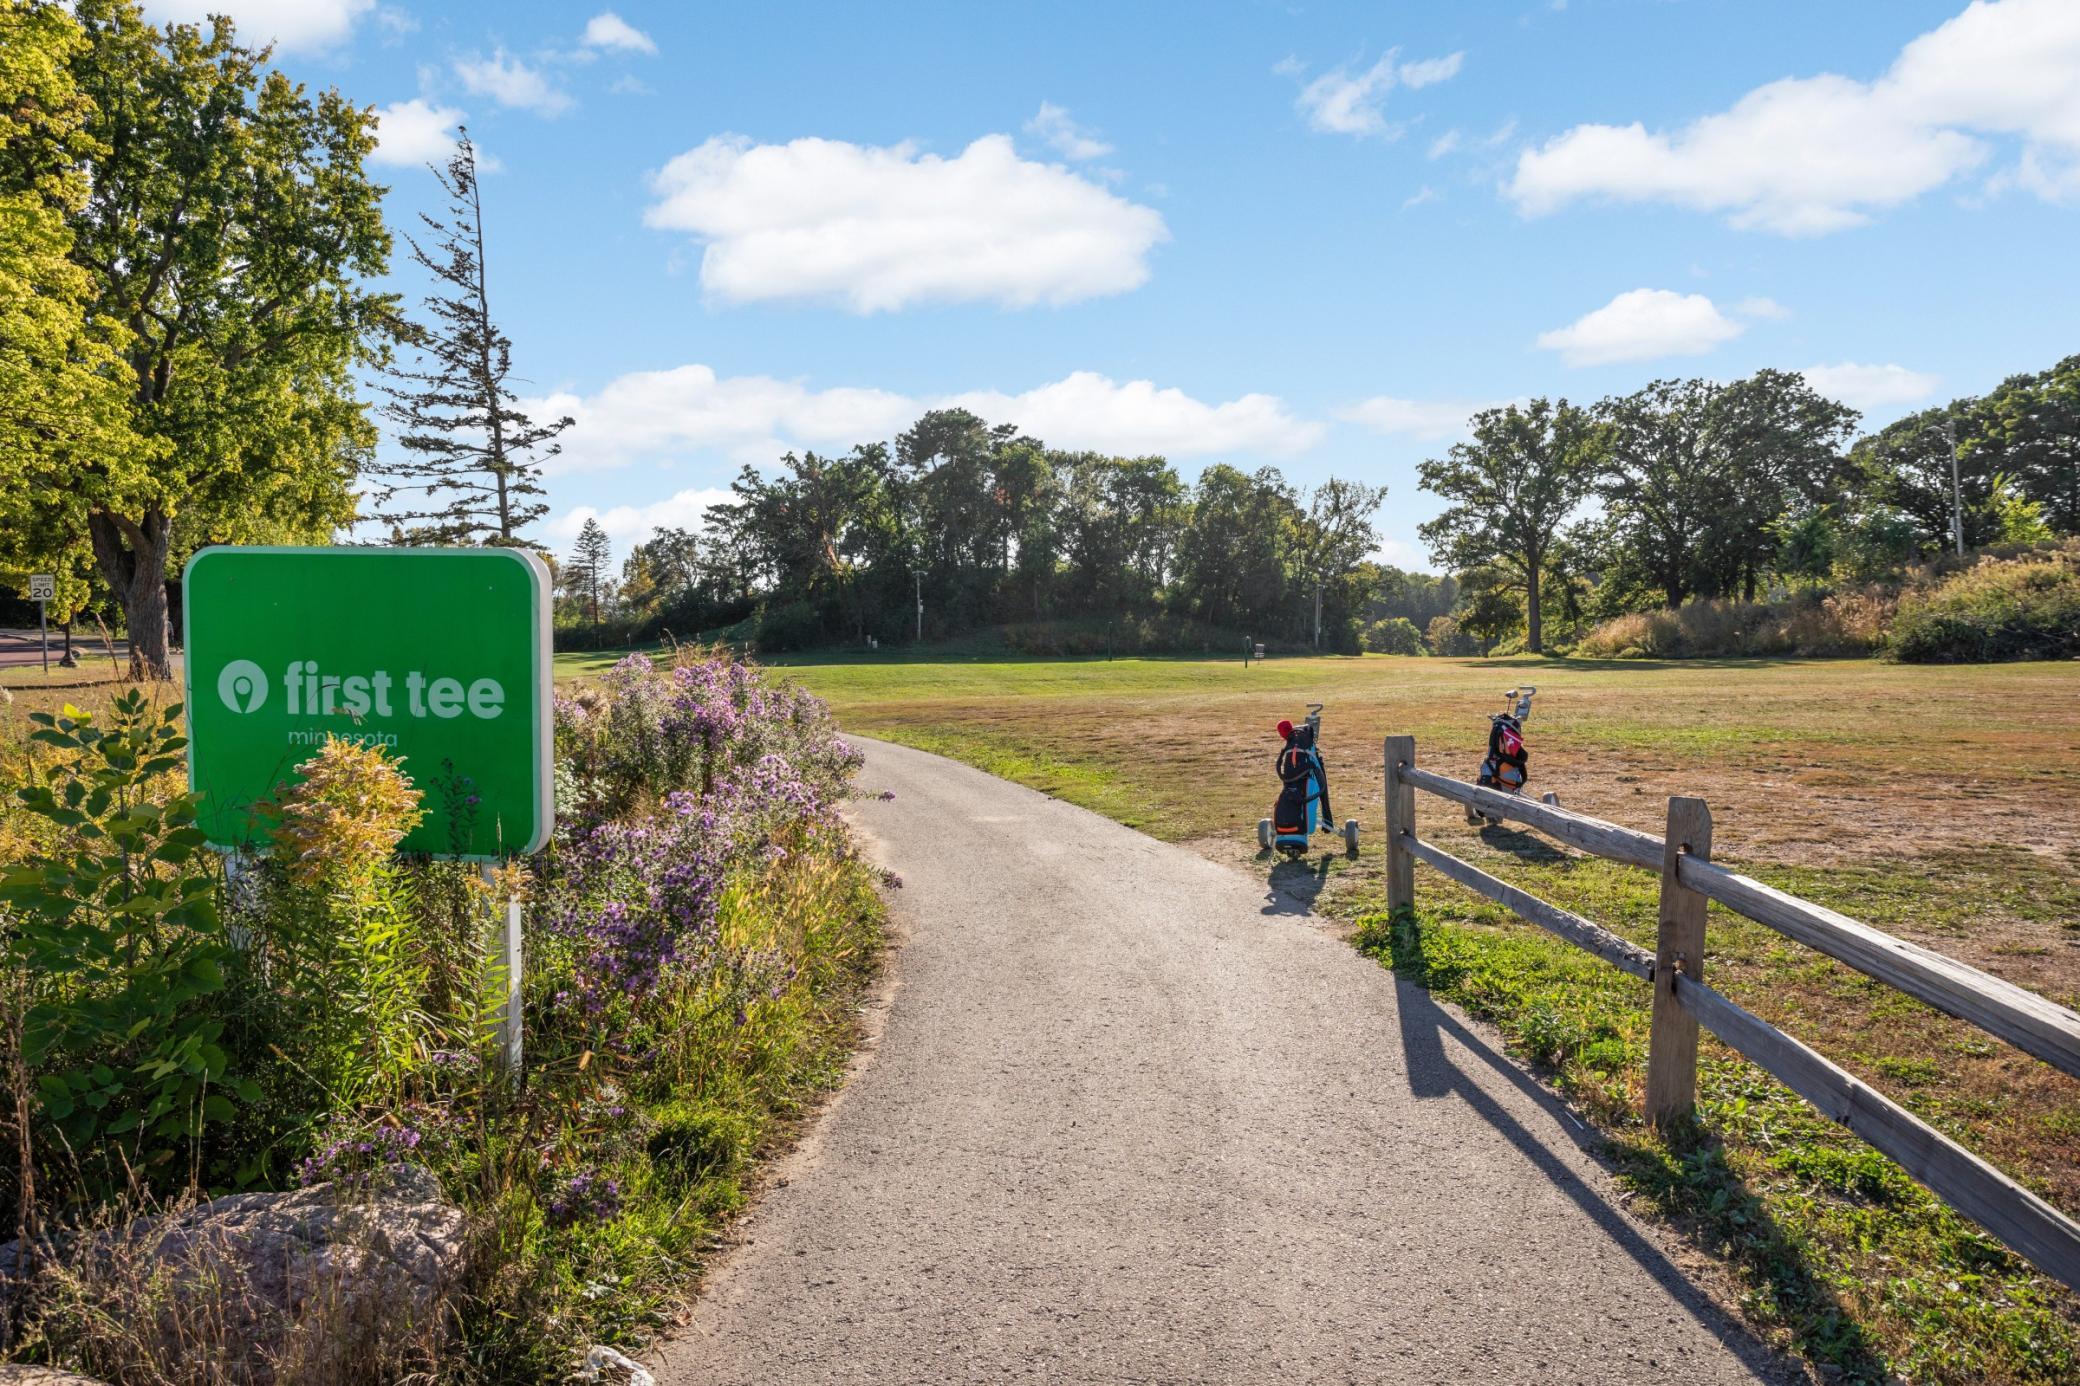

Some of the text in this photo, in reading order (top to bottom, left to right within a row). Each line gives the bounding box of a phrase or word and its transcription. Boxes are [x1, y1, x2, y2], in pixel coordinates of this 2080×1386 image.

[33, 588, 52, 598] 20
[284, 660, 505, 719] first tee
